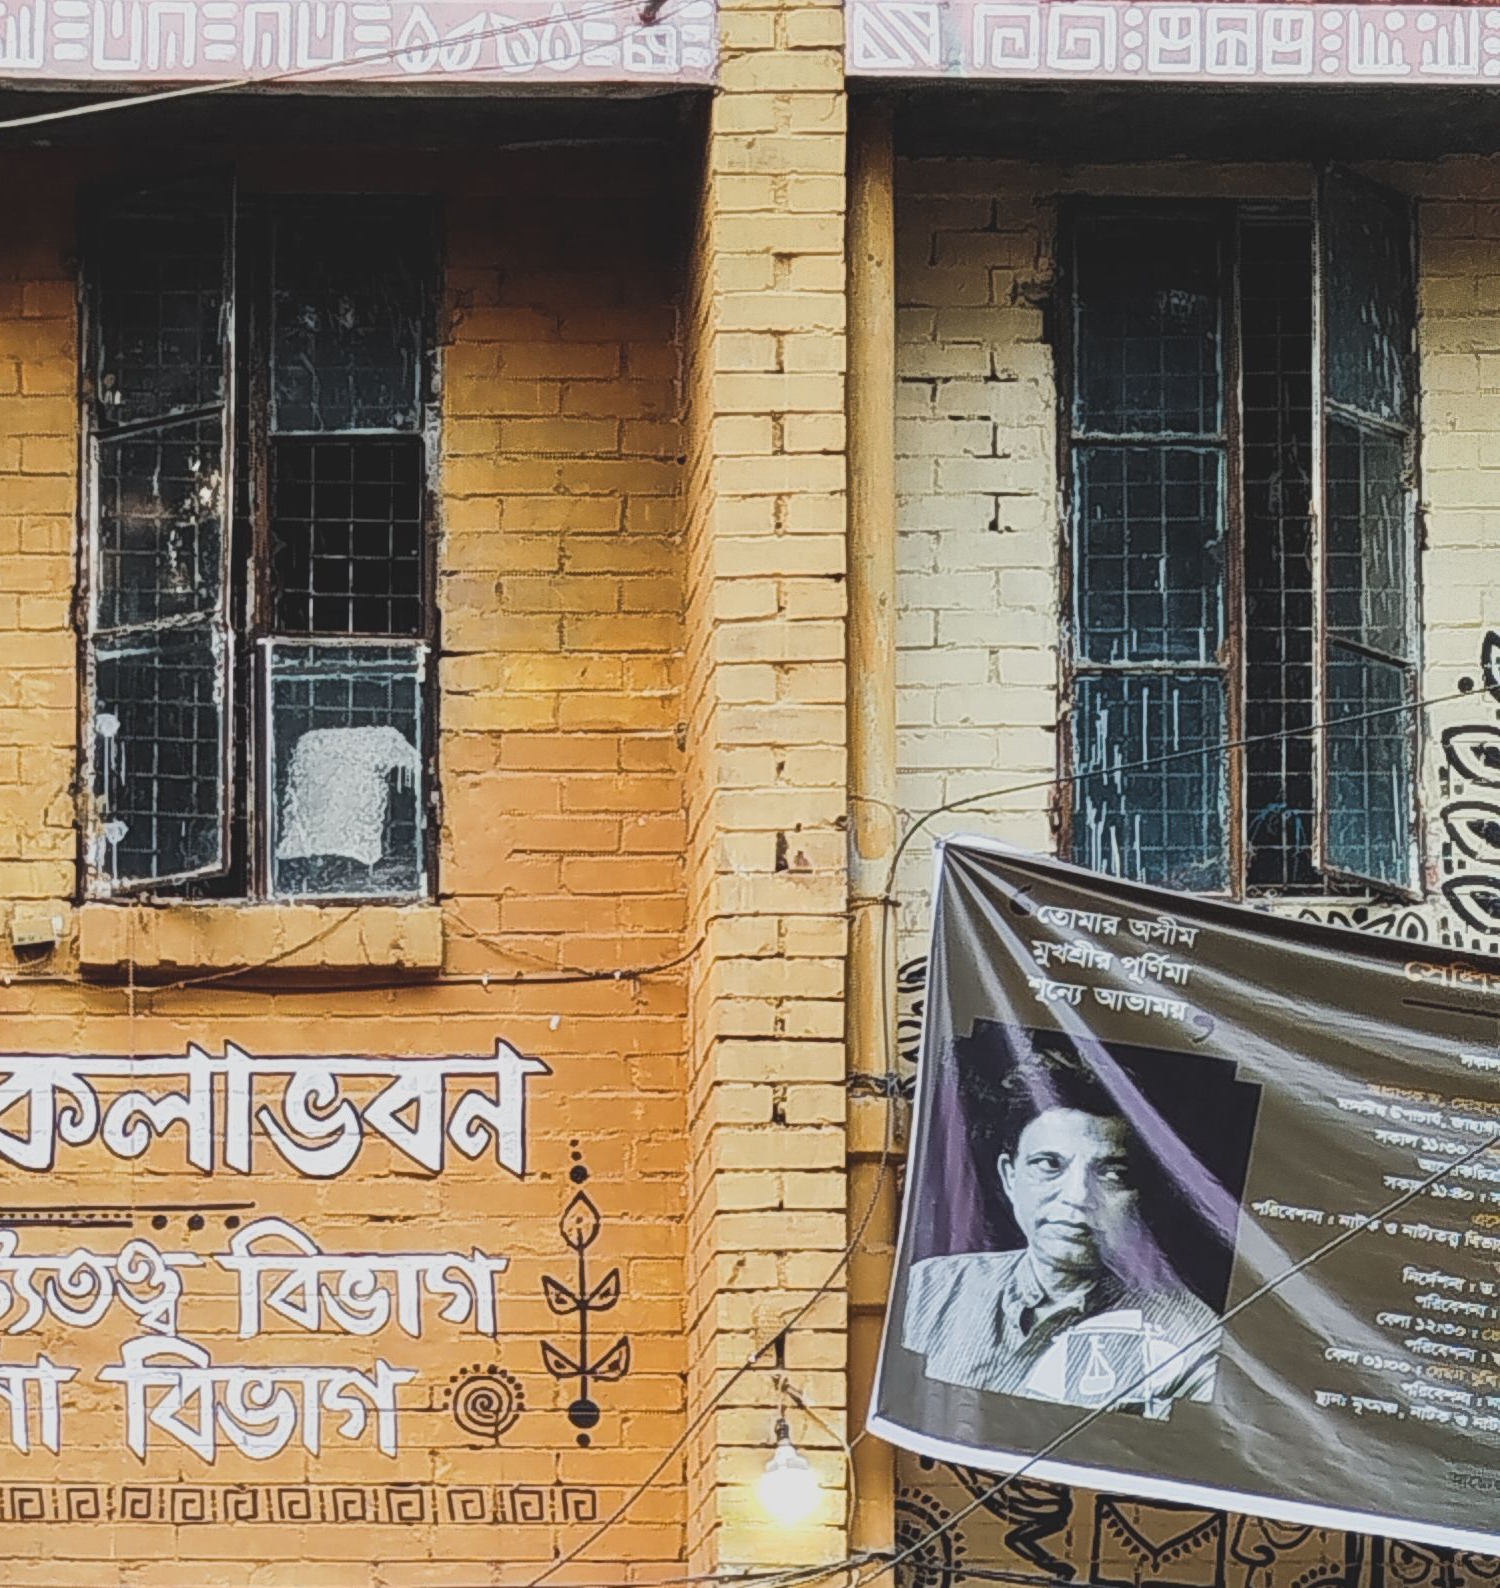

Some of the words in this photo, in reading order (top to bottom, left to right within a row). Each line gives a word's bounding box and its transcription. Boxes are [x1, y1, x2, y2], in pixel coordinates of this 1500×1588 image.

[1036, 904, 1121, 935] তোমার
[1128, 915, 1199, 948] অসীম
[1031, 939, 1114, 971] মুখশ্রীর
[1121, 953, 1192, 985] পূর্ণিমা
[1027, 973, 1087, 1005] শূন্যে
[1092, 986, 1190, 1021] আভাময়
[210, 1217, 508, 1341] বিভাগ
[98, 1331, 418, 1463] বিভাগ
